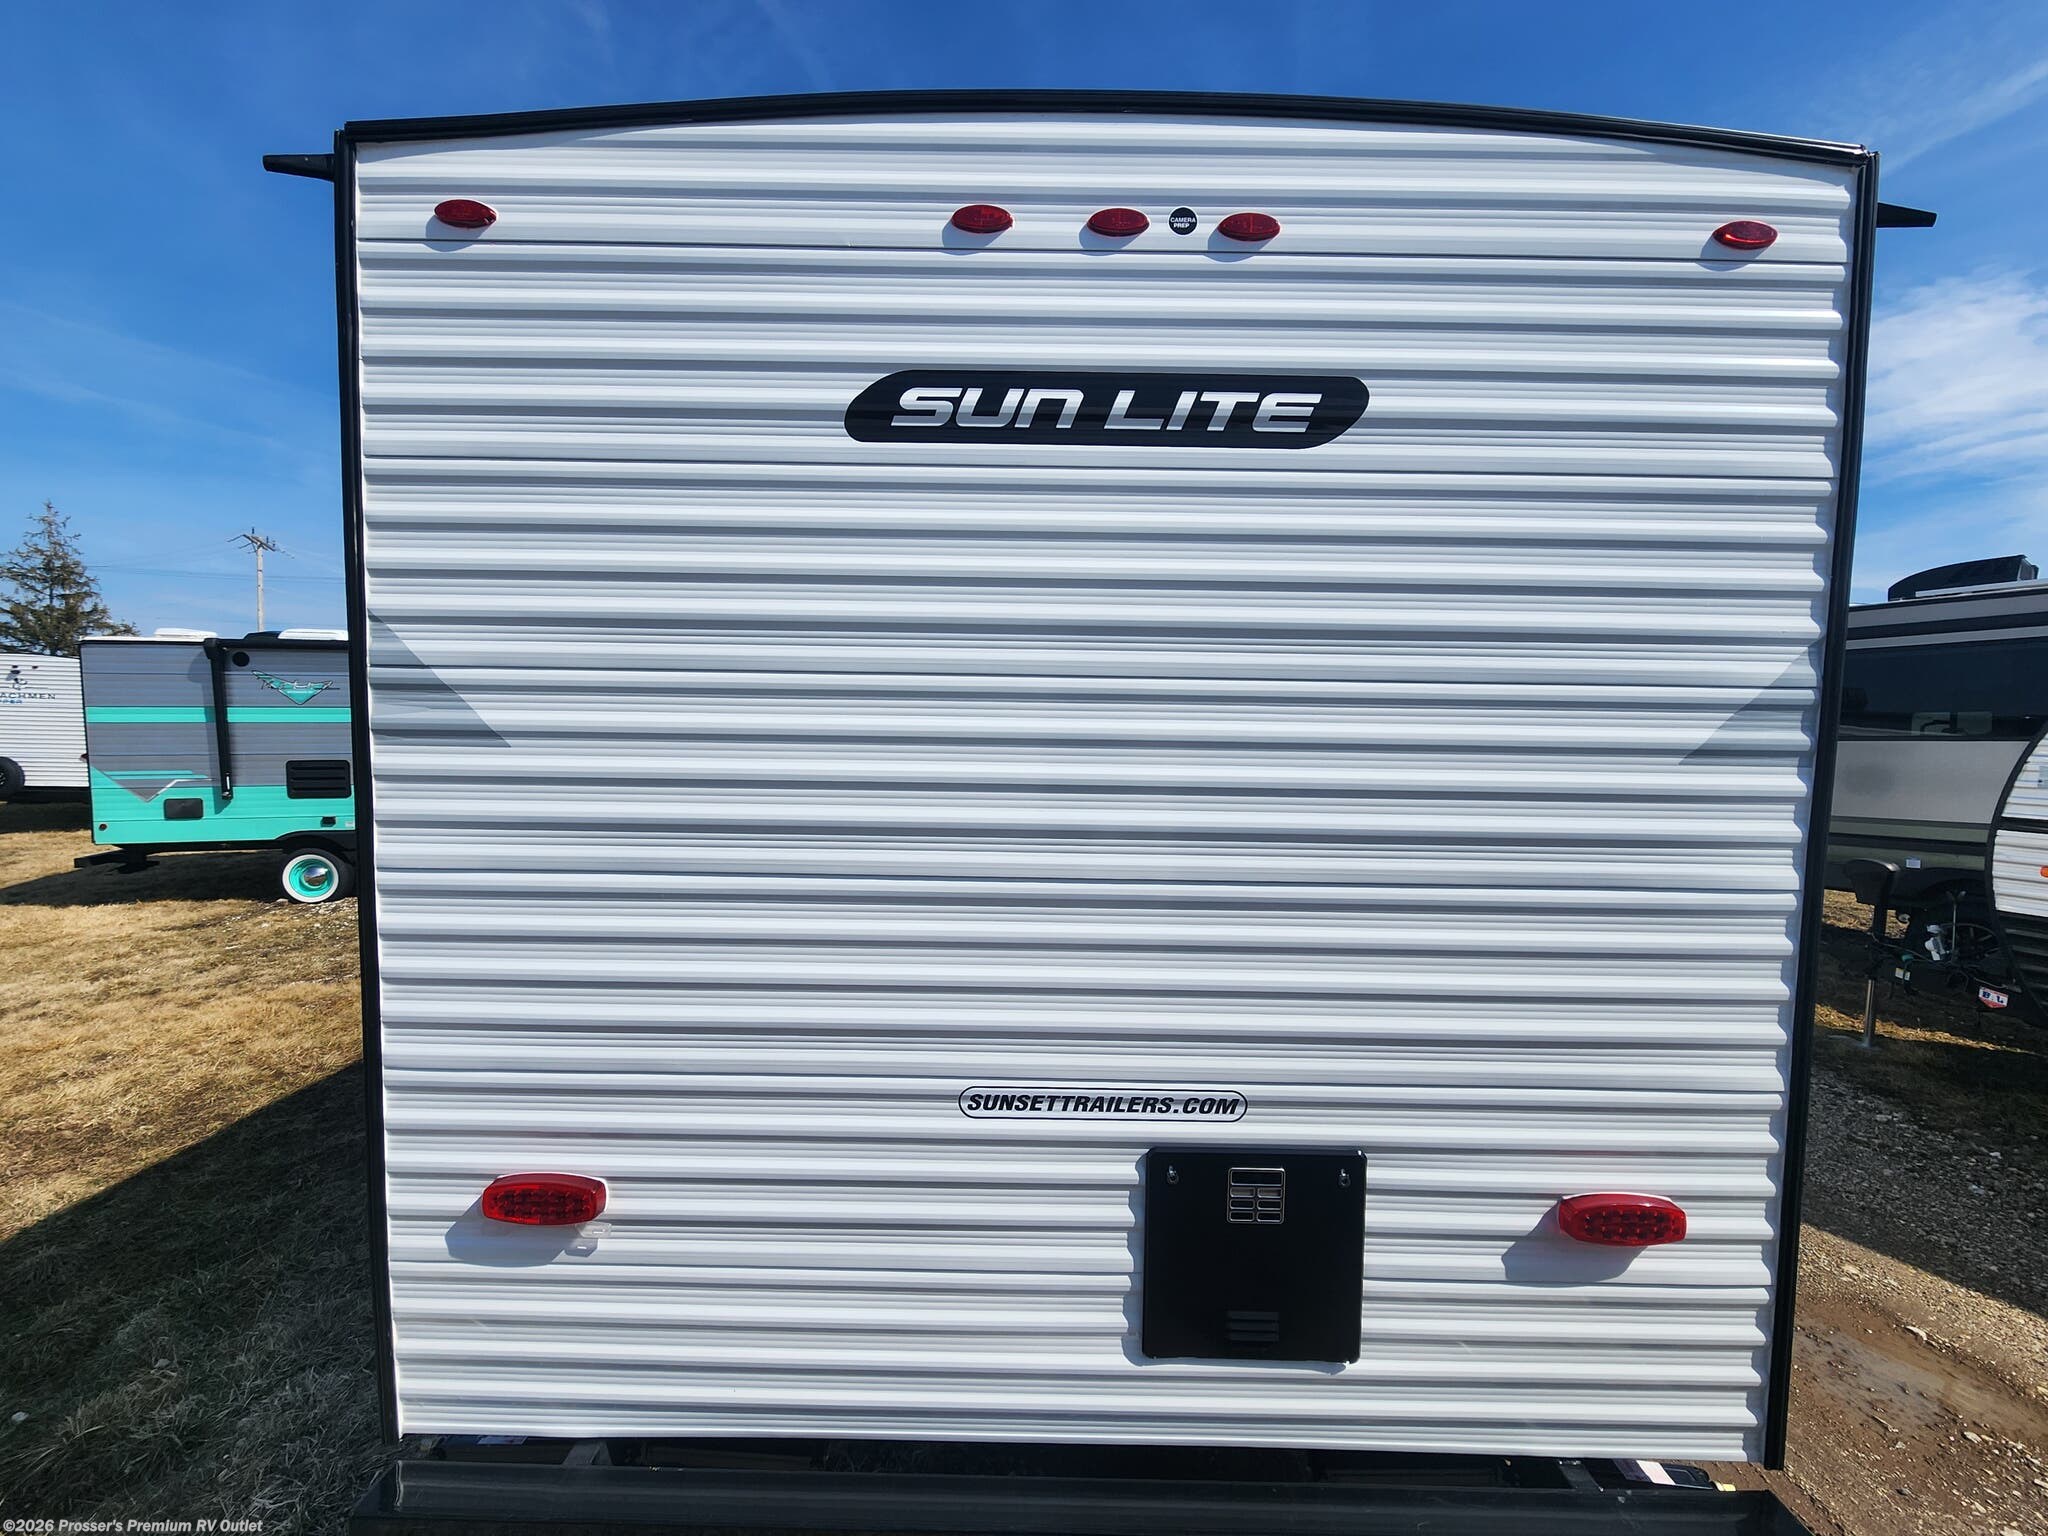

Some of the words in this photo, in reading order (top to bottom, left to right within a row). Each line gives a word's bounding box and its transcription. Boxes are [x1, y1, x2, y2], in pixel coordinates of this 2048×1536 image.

[891, 387, 1084, 429] SUN
[1104, 389, 1322, 433] LITE
[967, 1094, 1239, 1114] SUNSETTRAILERS.COM
